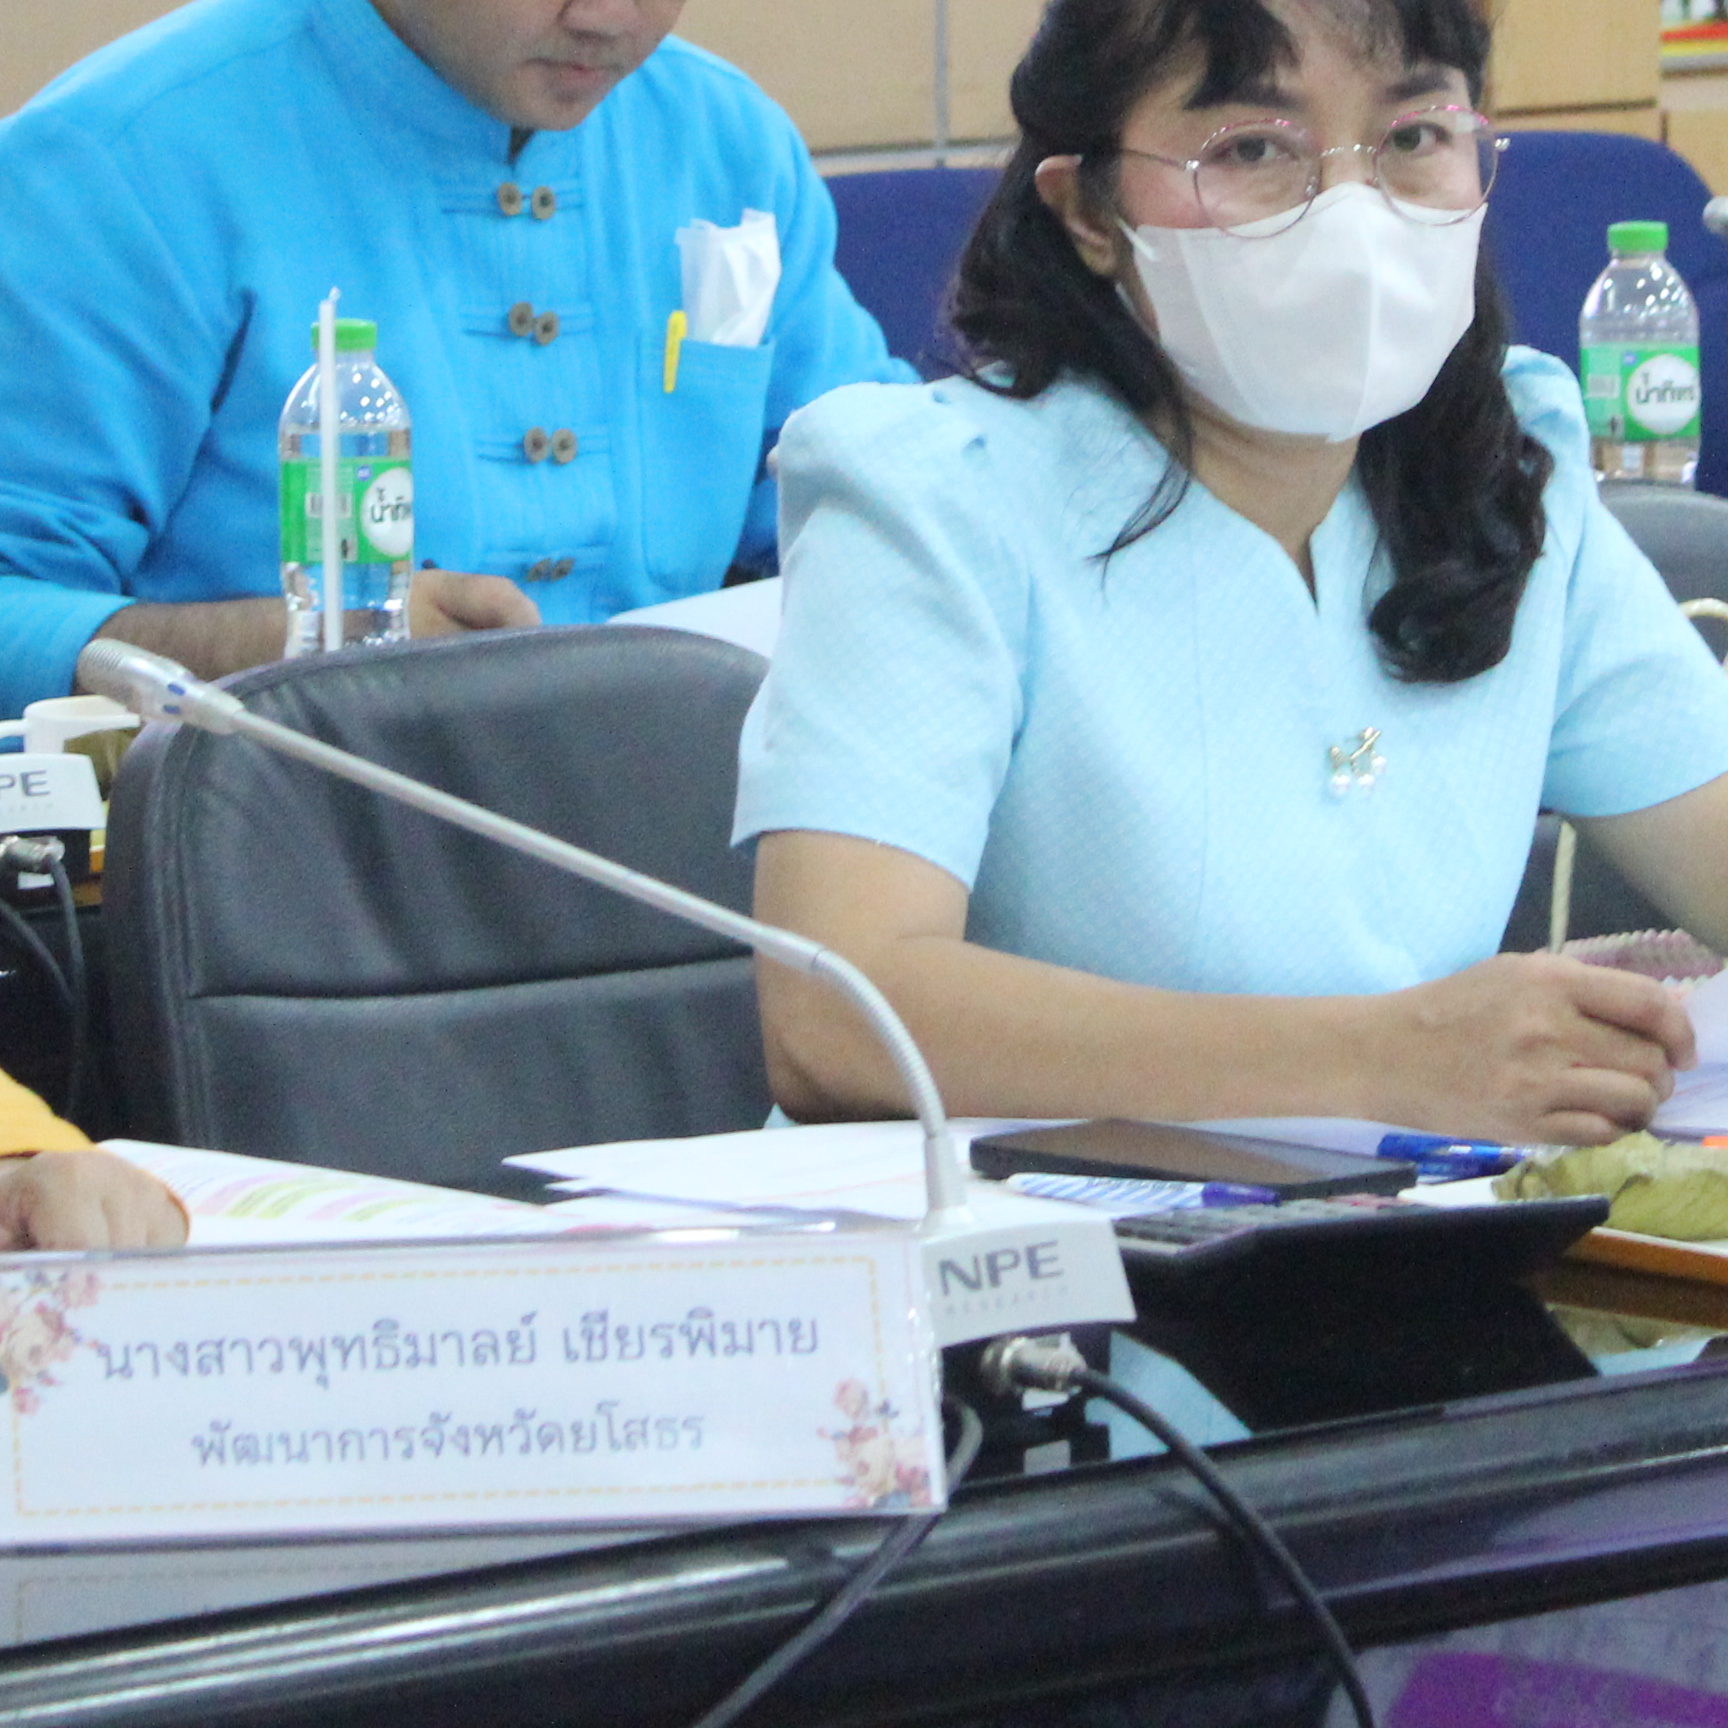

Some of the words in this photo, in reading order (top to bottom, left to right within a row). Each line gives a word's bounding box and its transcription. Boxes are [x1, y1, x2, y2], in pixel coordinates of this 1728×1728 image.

[938, 1239, 1066, 1297] NPE
[96, 1310, 538, 1390] นางสาวพุทธิมาลย์
[190, 1397, 706, 1467] พัฒนาการจังหวัดยโสธร
